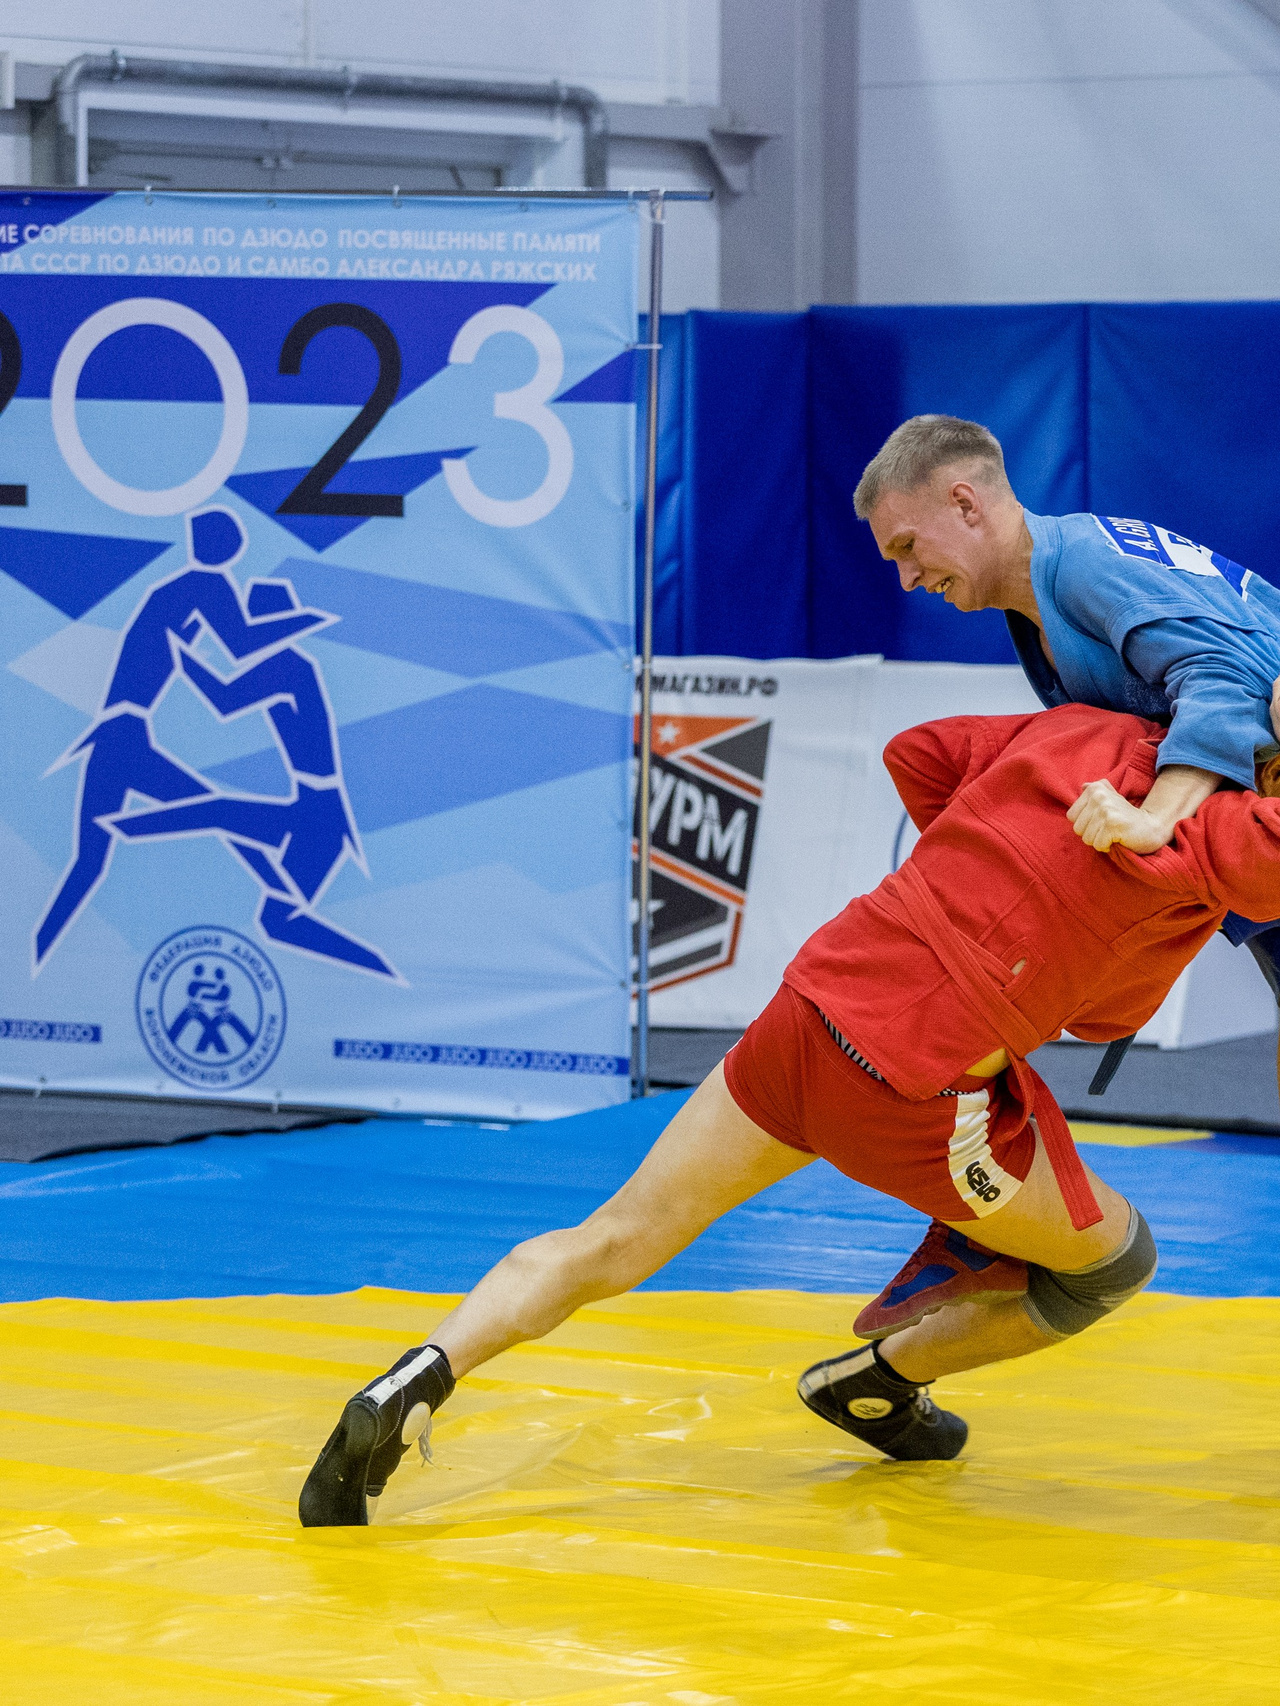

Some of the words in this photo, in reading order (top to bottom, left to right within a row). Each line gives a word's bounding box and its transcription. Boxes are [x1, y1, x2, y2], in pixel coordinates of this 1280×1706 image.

[23, 224, 194, 246] СОРЕВНОВАНИЯ
[203, 227, 235, 247] ПО
[241, 228, 328, 249] ДЗЮДО
[338, 228, 506, 252] ПОСВЯЩЕННЫЕ
[513, 231, 600, 253] ПАМЯТИ
[31, 253, 91, 274] СССР
[97, 254, 130, 275] ПО
[135, 255, 221, 277] ДЗЮДО
[228, 257, 241, 276] И
[249, 256, 329, 278] САМБО
[337, 258, 483, 282] АЛЕКСАНДРА
[490, 260, 597, 284] РЯЖСКИХ
[0, 297, 574, 528] 023
